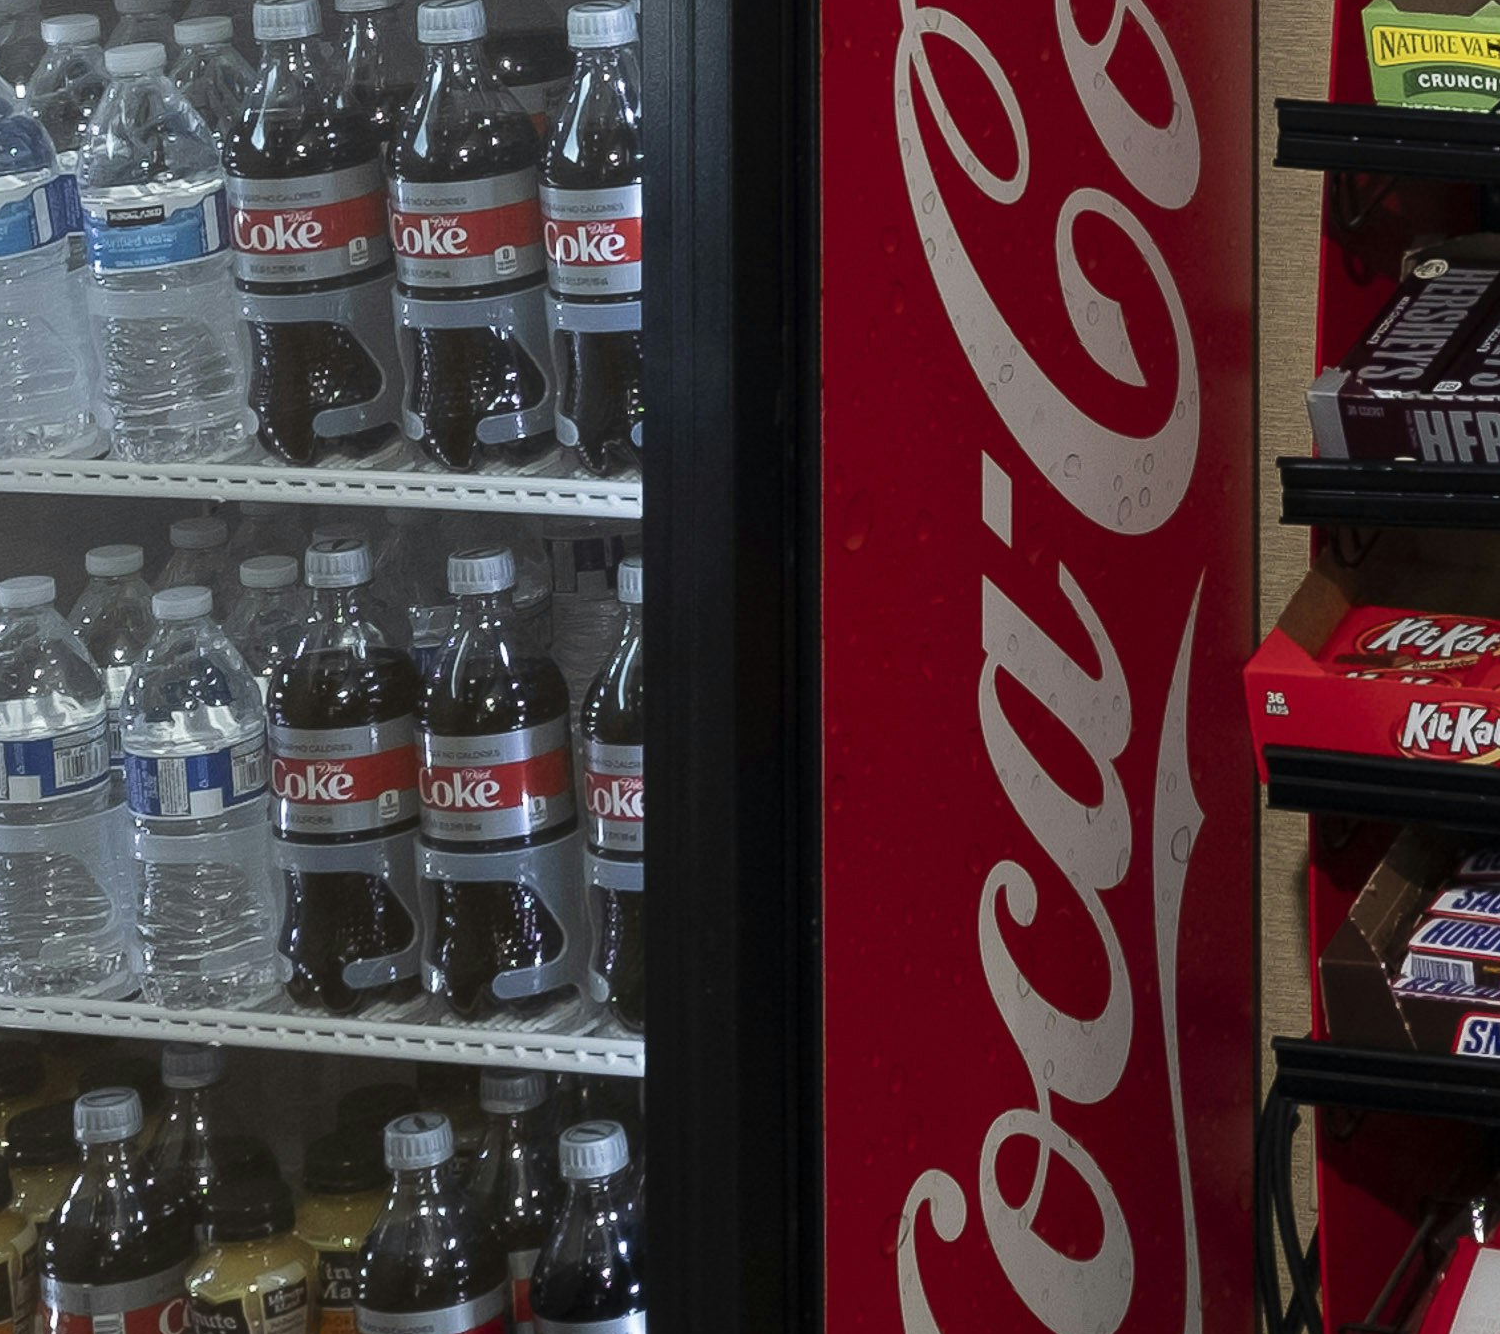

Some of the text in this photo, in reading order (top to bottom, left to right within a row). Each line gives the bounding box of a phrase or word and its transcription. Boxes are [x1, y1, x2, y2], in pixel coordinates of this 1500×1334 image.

[1379, 30, 1458, 60] NATURE
[232, 211, 323, 252] Coke
[390, 214, 468, 256] Coke
[544, 221, 626, 262] Coke
[1370, 269, 1500, 382] HERSHEY'S
[1266, 691, 1285, 704] 36
[271, 759, 354, 800] Coke
[418, 767, 500, 808] Coke
